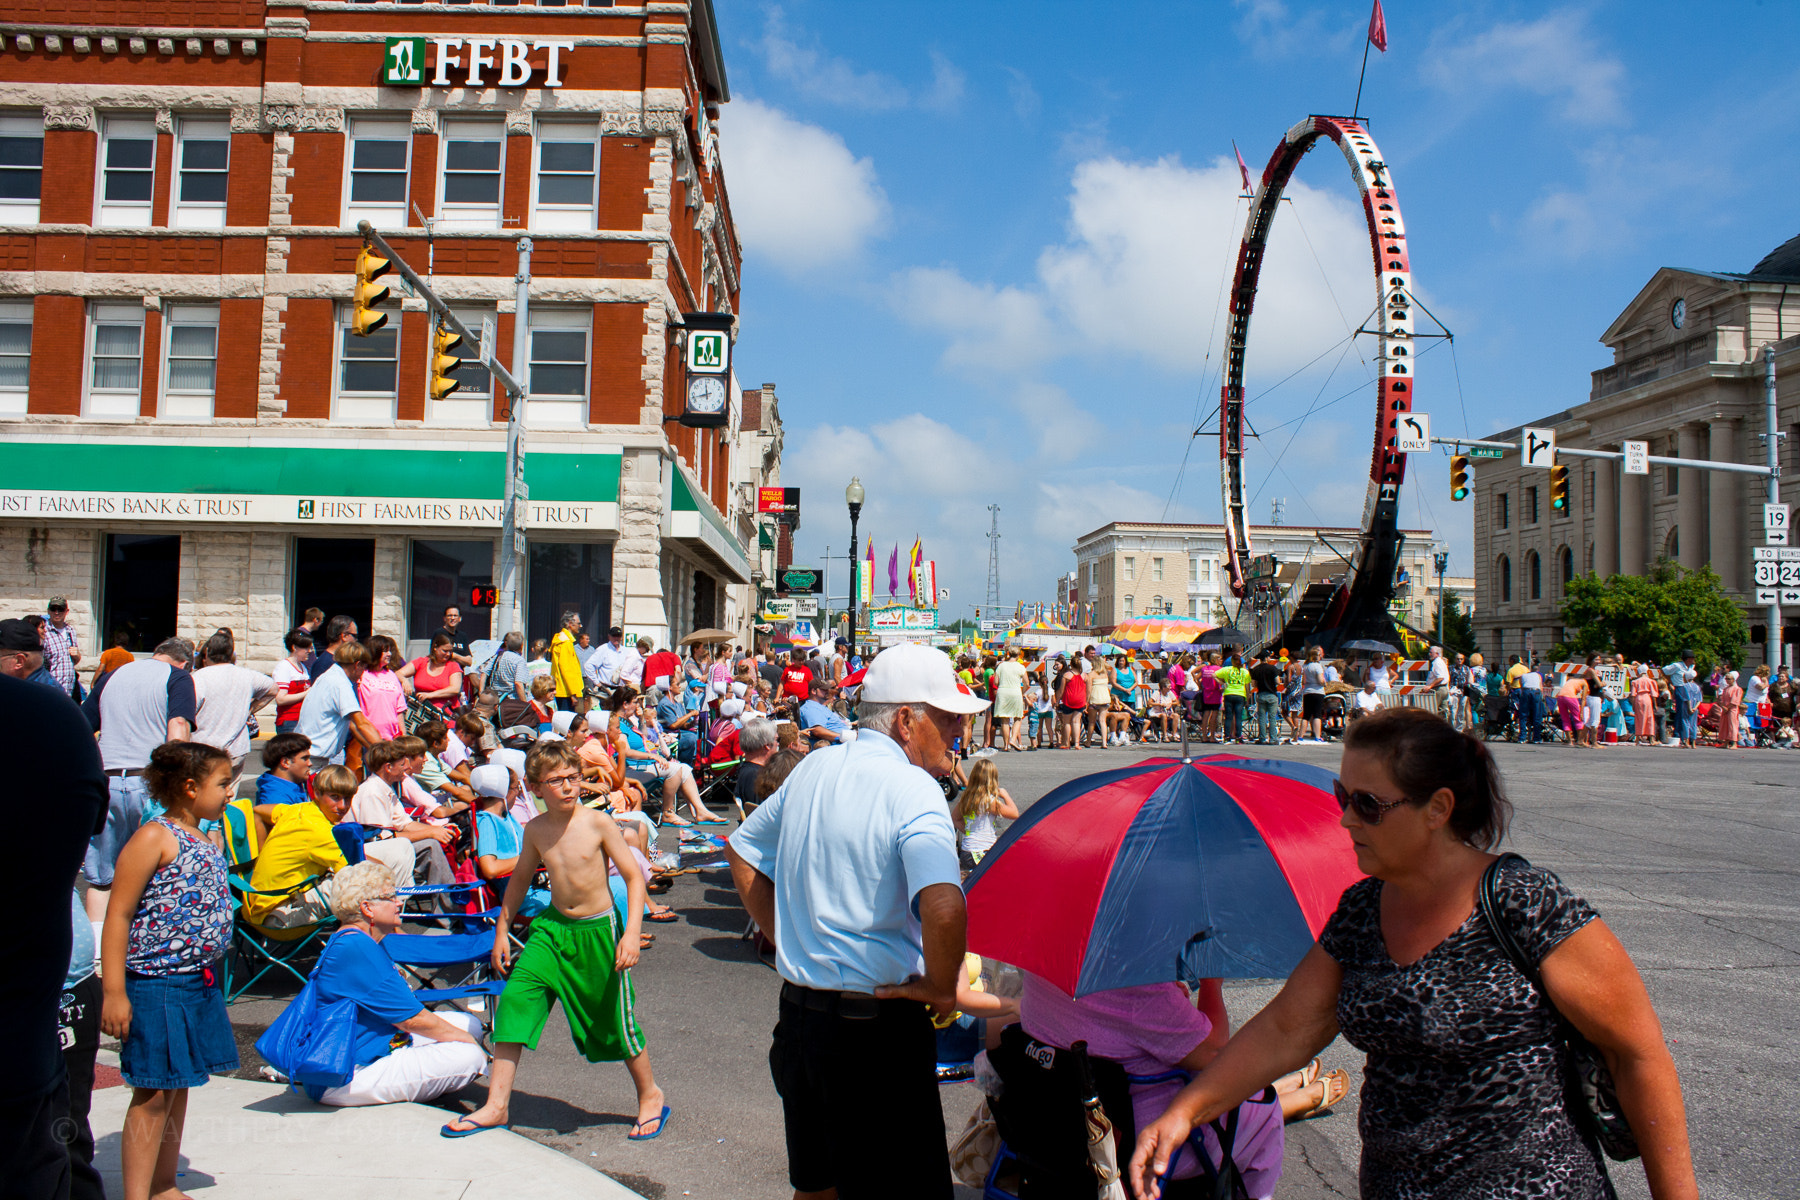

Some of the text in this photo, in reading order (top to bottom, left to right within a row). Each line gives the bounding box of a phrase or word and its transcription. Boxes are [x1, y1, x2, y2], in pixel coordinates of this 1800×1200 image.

[431, 38, 575, 86] FFBT
[1402, 441, 1426, 449] ONLY
[1477, 449, 1494, 457] MAIN
[39, 496, 116, 513] FARMERS
[123, 498, 173, 514] BANK
[176, 499, 191, 515] &
[194, 499, 252, 516] TRUST
[321, 502, 367, 518] FIRST
[374, 503, 452, 520] FARMERS
[532, 506, 593, 523] TRUST
[1769, 512, 1785, 526] 19
[1760, 567, 1774, 580] 31
[1782, 567, 1800, 580] 24
[485, 589, 494, 604] 15
[766, 601, 793, 609] Computer
[1601, 671, 1623, 682] TREET
[1025, 1040, 1053, 1067] hugo
